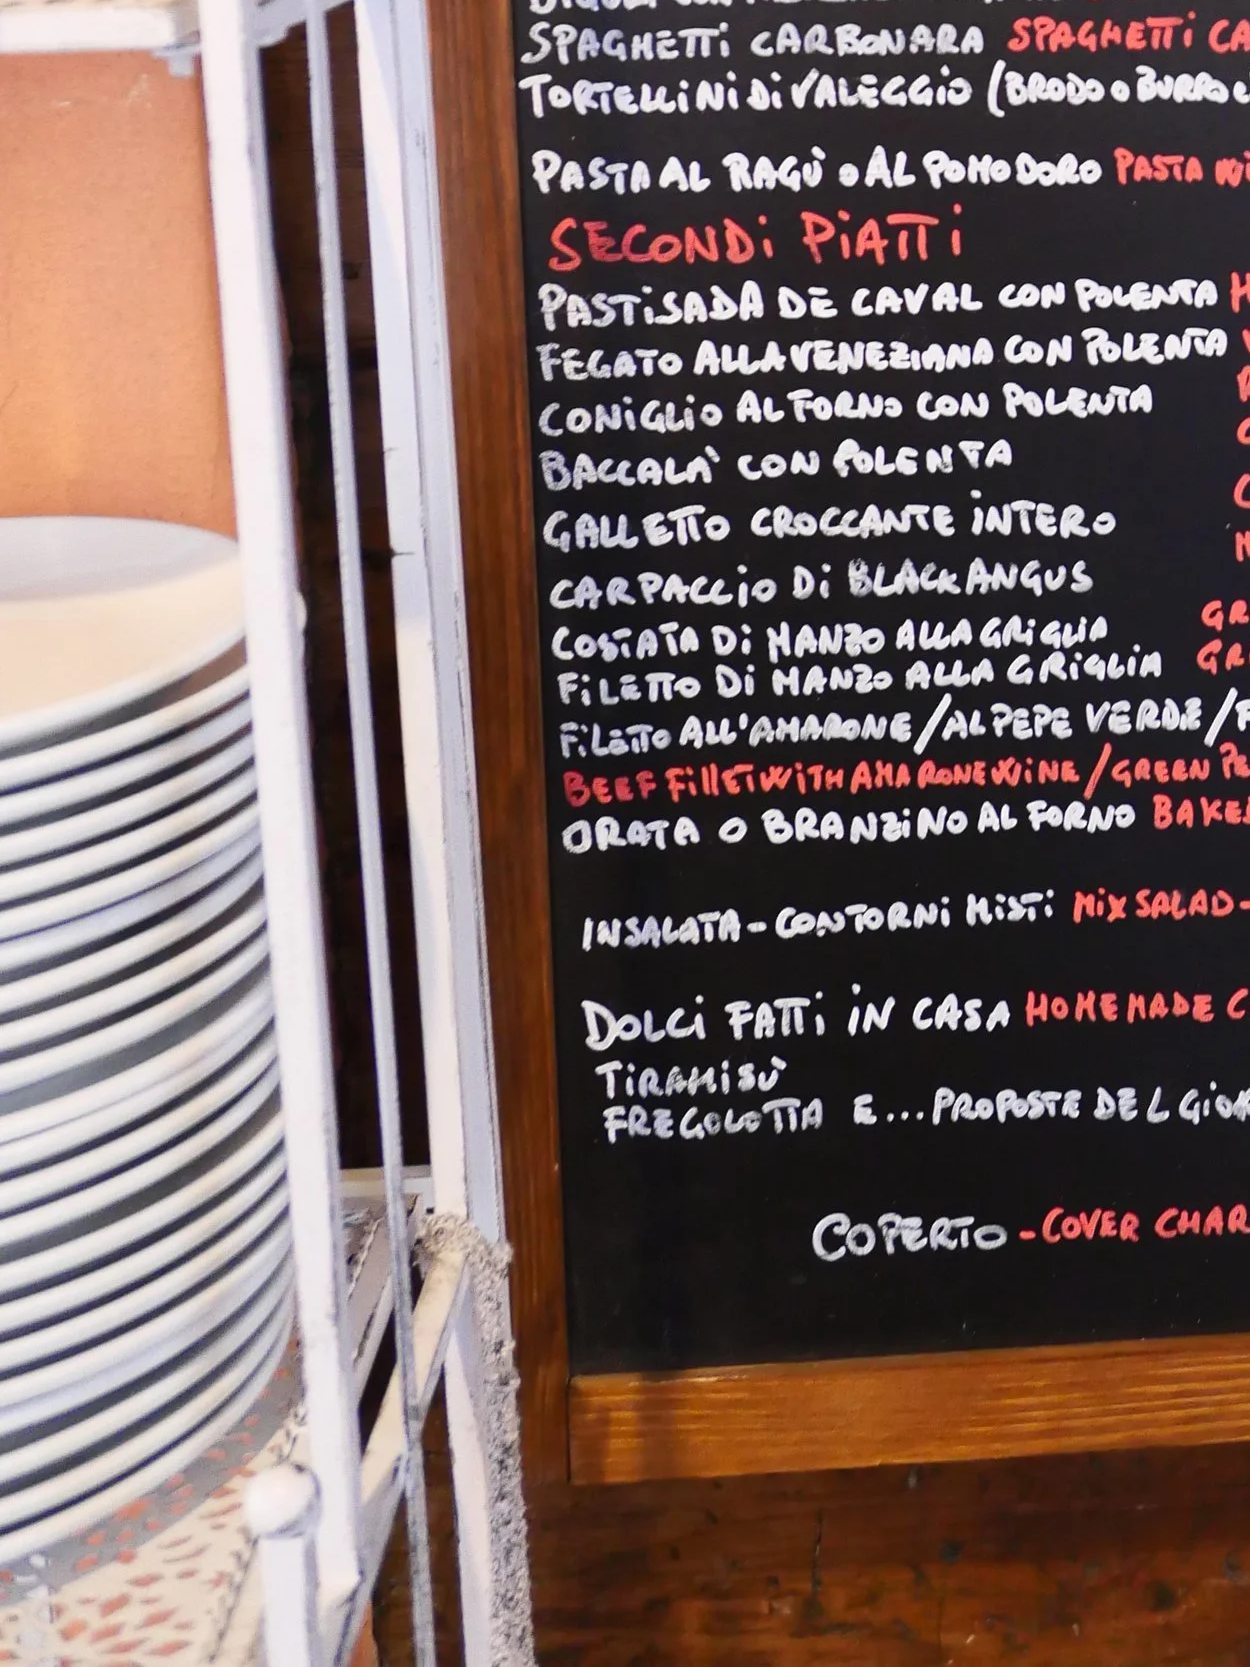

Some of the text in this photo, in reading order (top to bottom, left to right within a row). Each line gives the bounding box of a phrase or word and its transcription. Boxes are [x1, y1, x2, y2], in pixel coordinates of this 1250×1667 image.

[750, 22, 984, 57] CARBONARA
[531, 149, 651, 195] PASTA
[658, 156, 711, 193] AL
[864, 144, 916, 189] AL
[922, 149, 1103, 190] POMODORO
[1112, 146, 1204, 186] PASTA
[777, 286, 838, 319] DE
[851, 281, 983, 317] CAVAL
[998, 281, 1066, 309] CON
[1074, 278, 1218, 313] POLENTA
[536, 342, 683, 382] FEGATO
[1003, 334, 1073, 367] CON
[1081, 327, 1228, 366] POLENTA
[736, 389, 785, 424] AL
[786, 388, 903, 423] FORNO
[916, 390, 990, 421] CON
[1002, 382, 1153, 419] POLENTA
[737, 450, 820, 481] CON
[832, 438, 1013, 478] POLENTA
[542, 504, 731, 553] GALLETTO
[750, 503, 956, 539] CROCCANTE
[965, 557, 1093, 597] ANGUS
[551, 621, 700, 662] COSTATA
[766, 621, 885, 664] MANZO
[771, 663, 893, 696] MANZO
[905, 658, 995, 690] ALLA
[562, 769, 657, 807] BEEF
[562, 816, 700, 854] ORATA
[977, 800, 1018, 833] AL
[1026, 799, 1136, 834] FORNO
[912, 993, 1011, 1032] CASA
[602, 1086, 1170, 1144] FREGOLOTTA PROPOSTE DEL
[812, 1212, 1007, 1262] COPERTO
